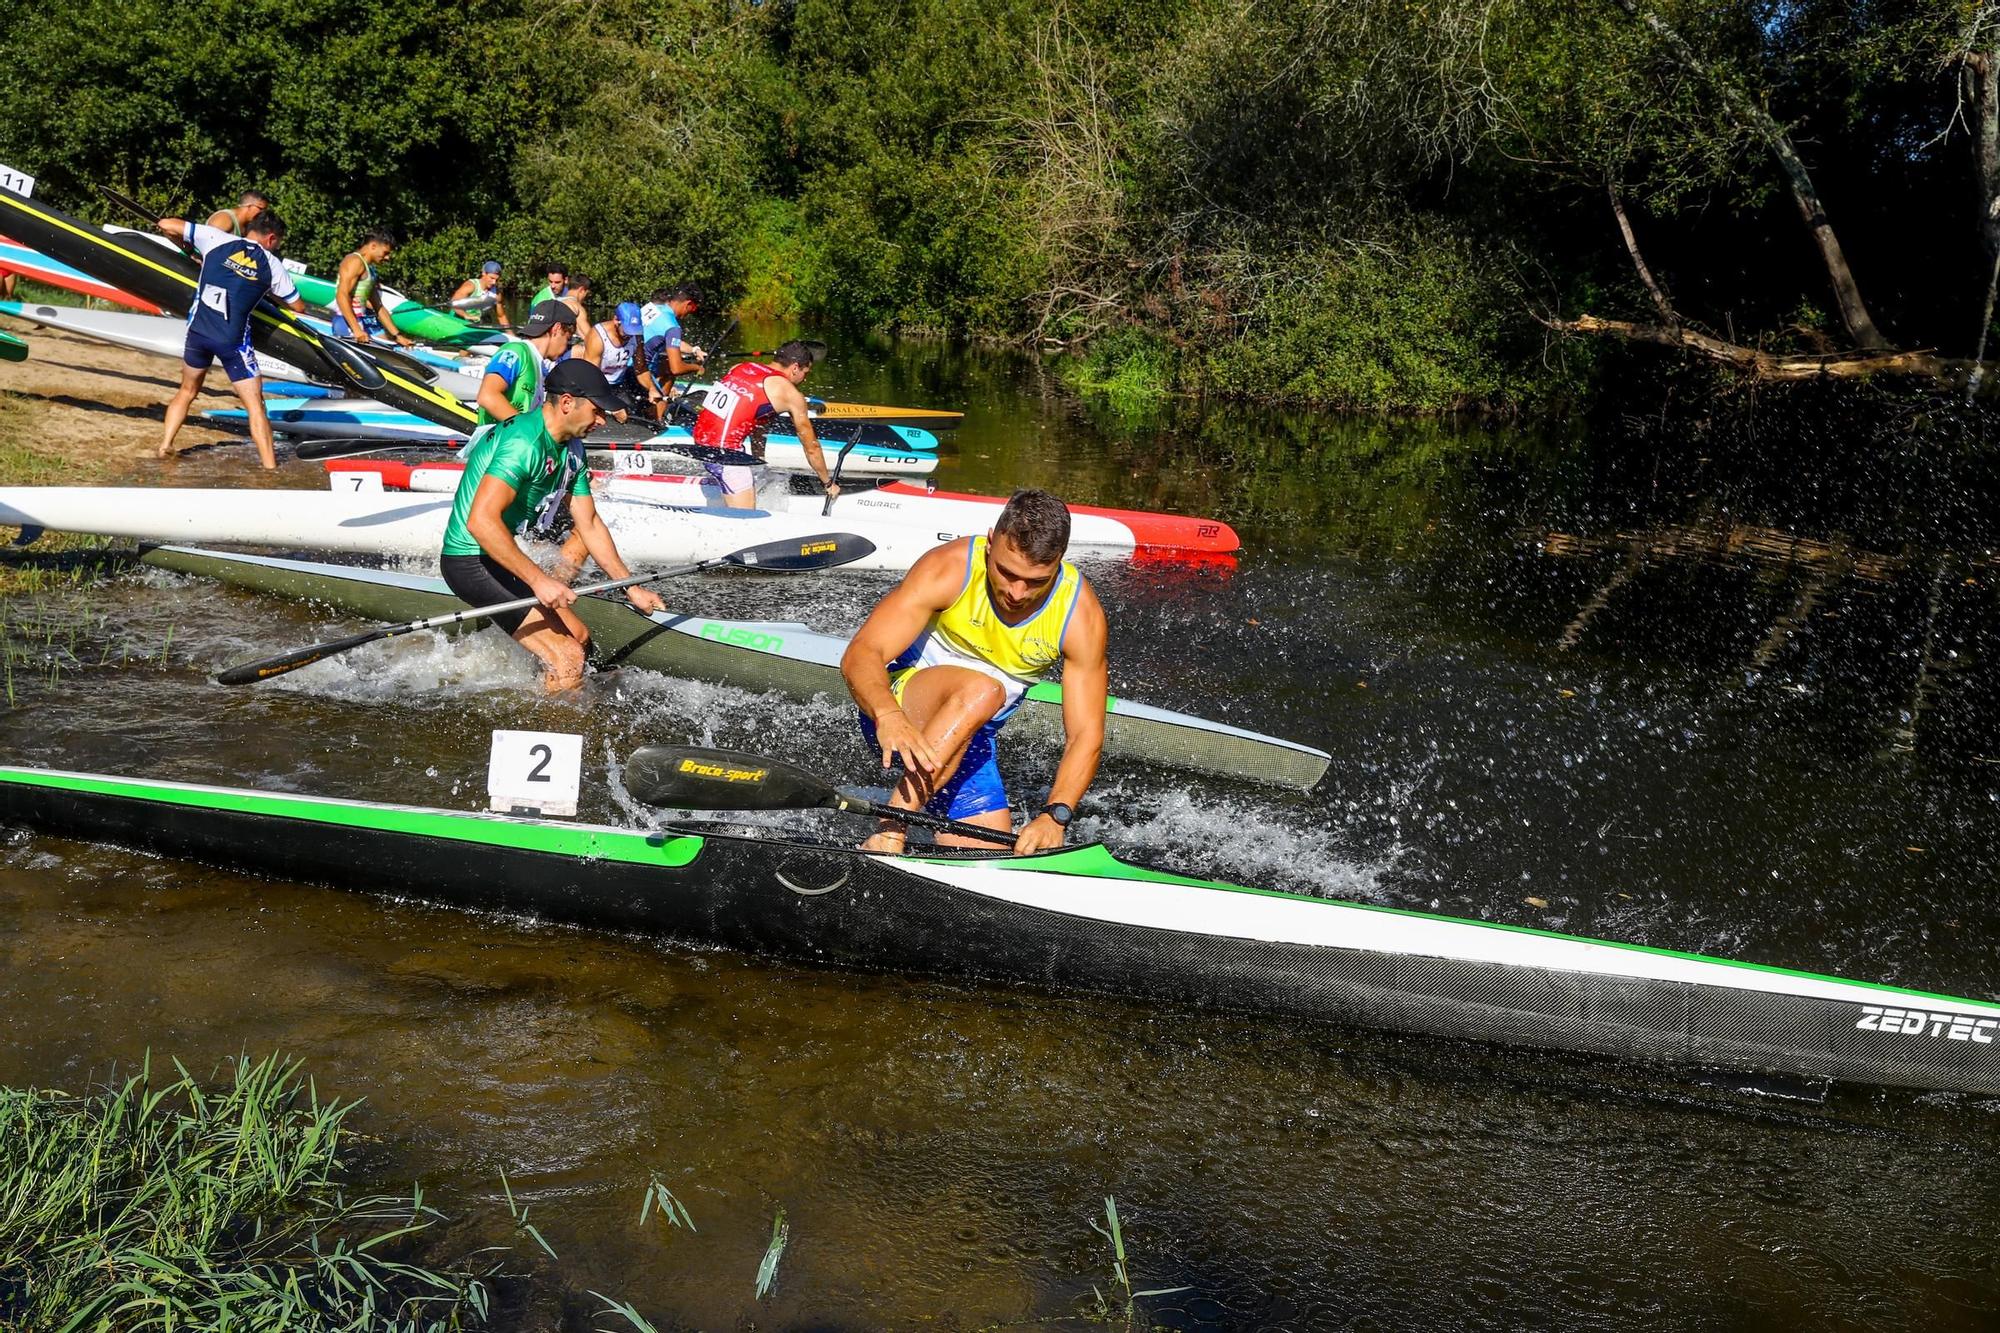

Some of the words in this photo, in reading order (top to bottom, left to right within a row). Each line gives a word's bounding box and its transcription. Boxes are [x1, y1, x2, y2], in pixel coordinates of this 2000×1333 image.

[3, 173, 24, 191] 11
[214, 292, 222, 304] 1
[616, 349, 630, 362] 12
[711, 390, 729, 410] 10
[625, 453, 645, 469] 10
[868, 455, 918, 464] ELIO
[350, 478, 363, 491] 7
[527, 744, 552, 782] 2
[1856, 1005, 2000, 1044] ZEDTEC
